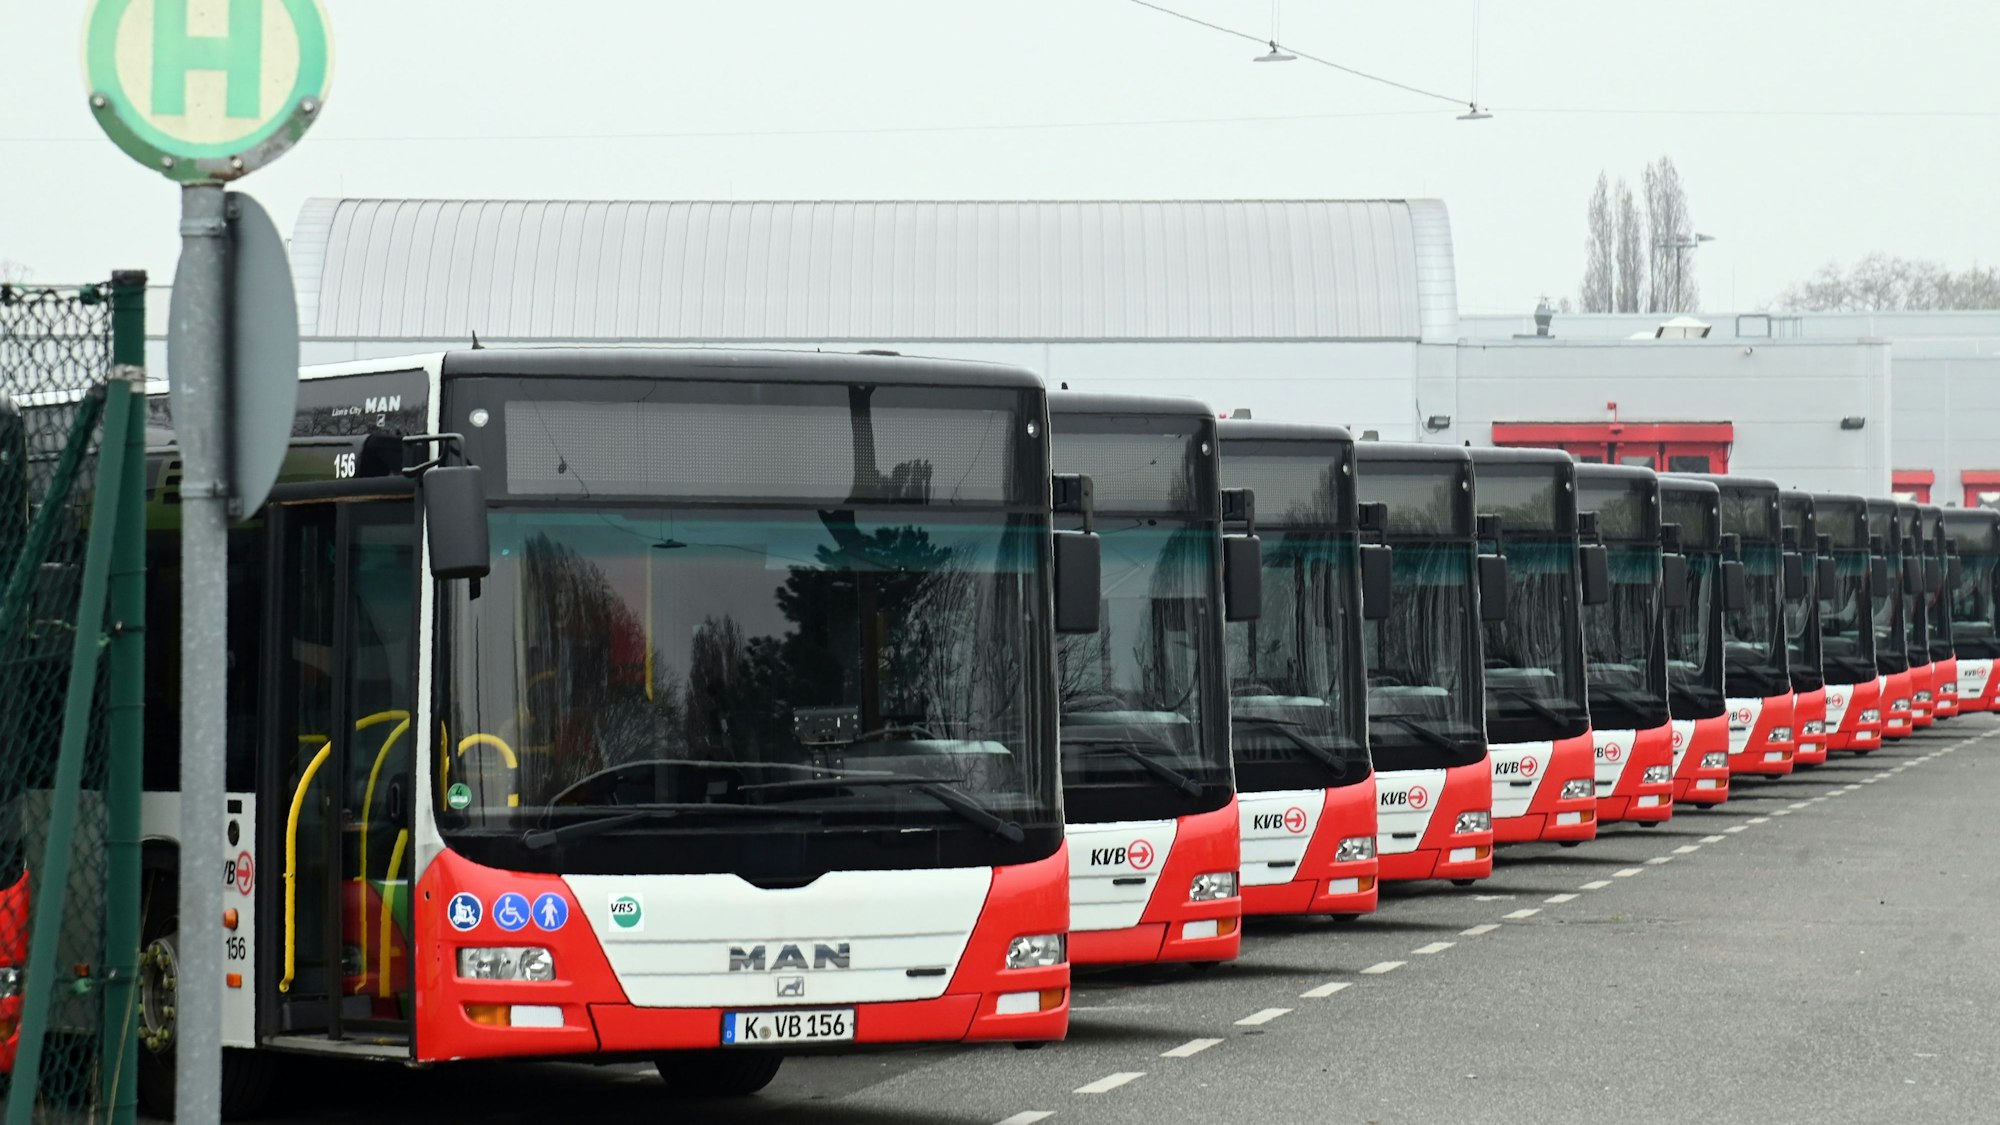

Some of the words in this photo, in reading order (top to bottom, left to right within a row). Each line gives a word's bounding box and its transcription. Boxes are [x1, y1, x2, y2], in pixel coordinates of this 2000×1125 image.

[151, 0, 263, 118] H
[364, 395, 401, 414] MAN
[334, 452, 356, 478] 156
[1495, 761, 1519, 775] KVB
[1380, 791, 1407, 806] KVB
[1253, 813, 1283, 830] KVB
[1090, 847, 1126, 866] KVB
[610, 902, 634, 913] VRS
[226, 936, 246, 960] 156
[729, 943, 850, 971] MAN
[745, 1016, 759, 1040] K
[775, 1014, 802, 1038] VB
[806, 1013, 846, 1038] 156
